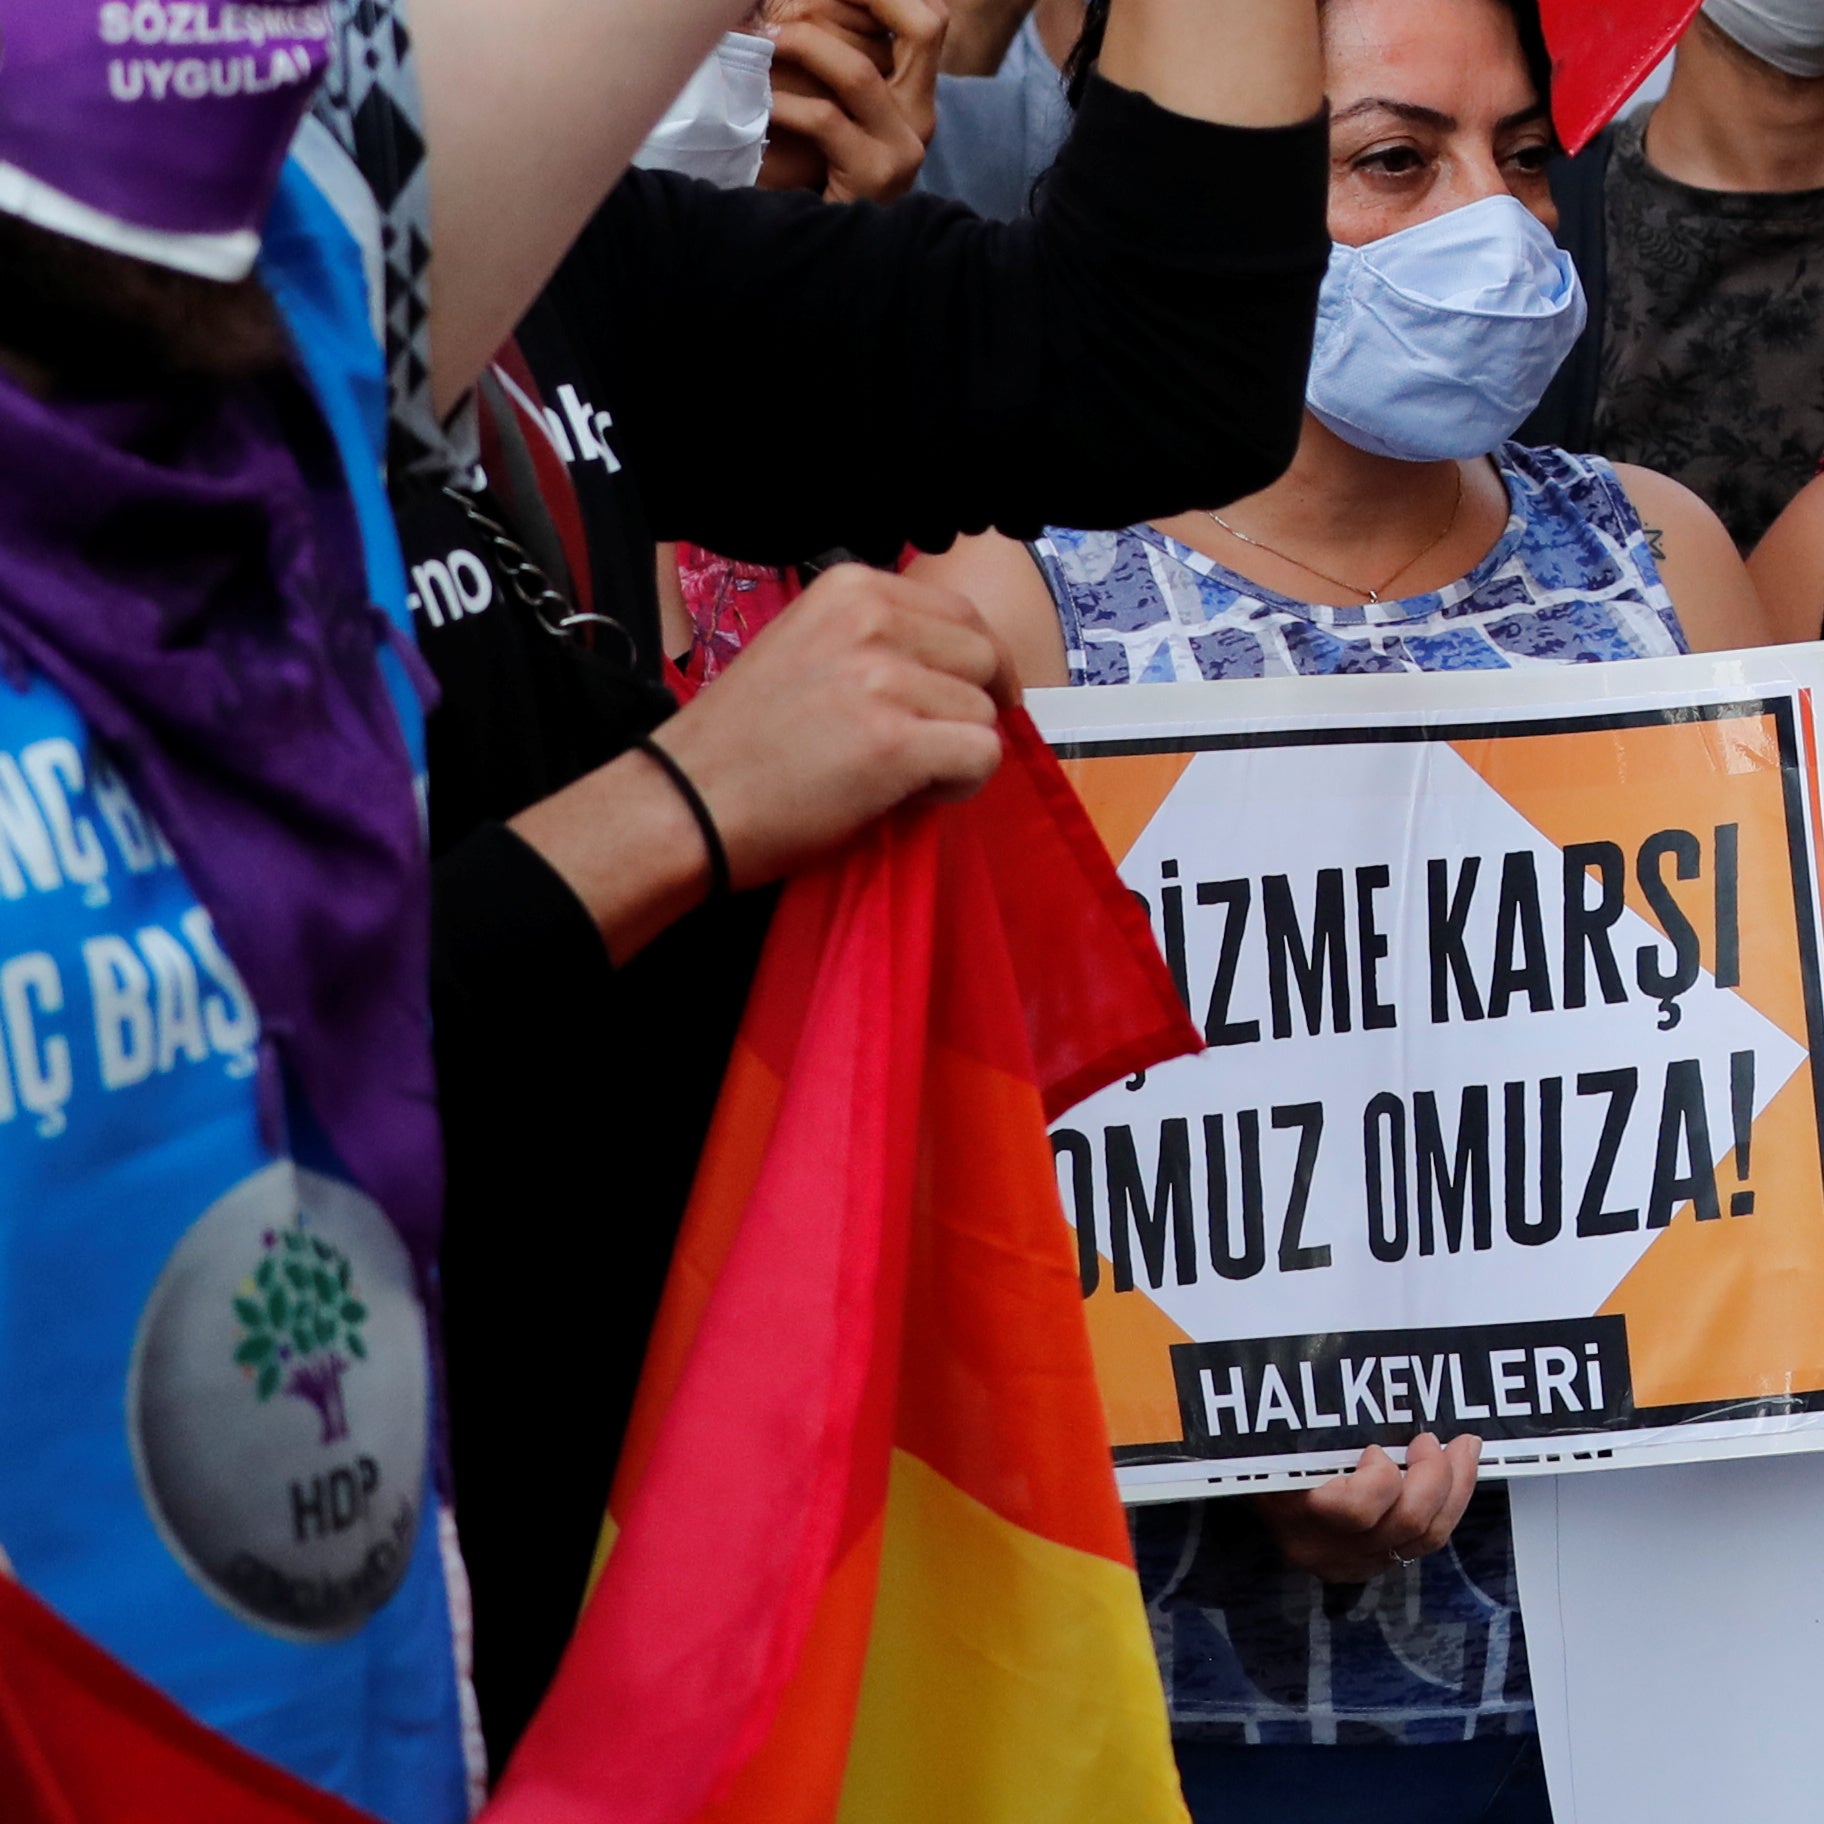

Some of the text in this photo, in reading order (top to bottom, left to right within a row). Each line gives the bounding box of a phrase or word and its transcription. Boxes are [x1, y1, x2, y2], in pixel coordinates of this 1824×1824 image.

[1125, 822, 1741, 1093] İZME KARŞI
[1049, 1049, 1760, 1301] OMUZ OMUZA!
[1198, 1340, 1605, 1440] HALKEVLERİ
